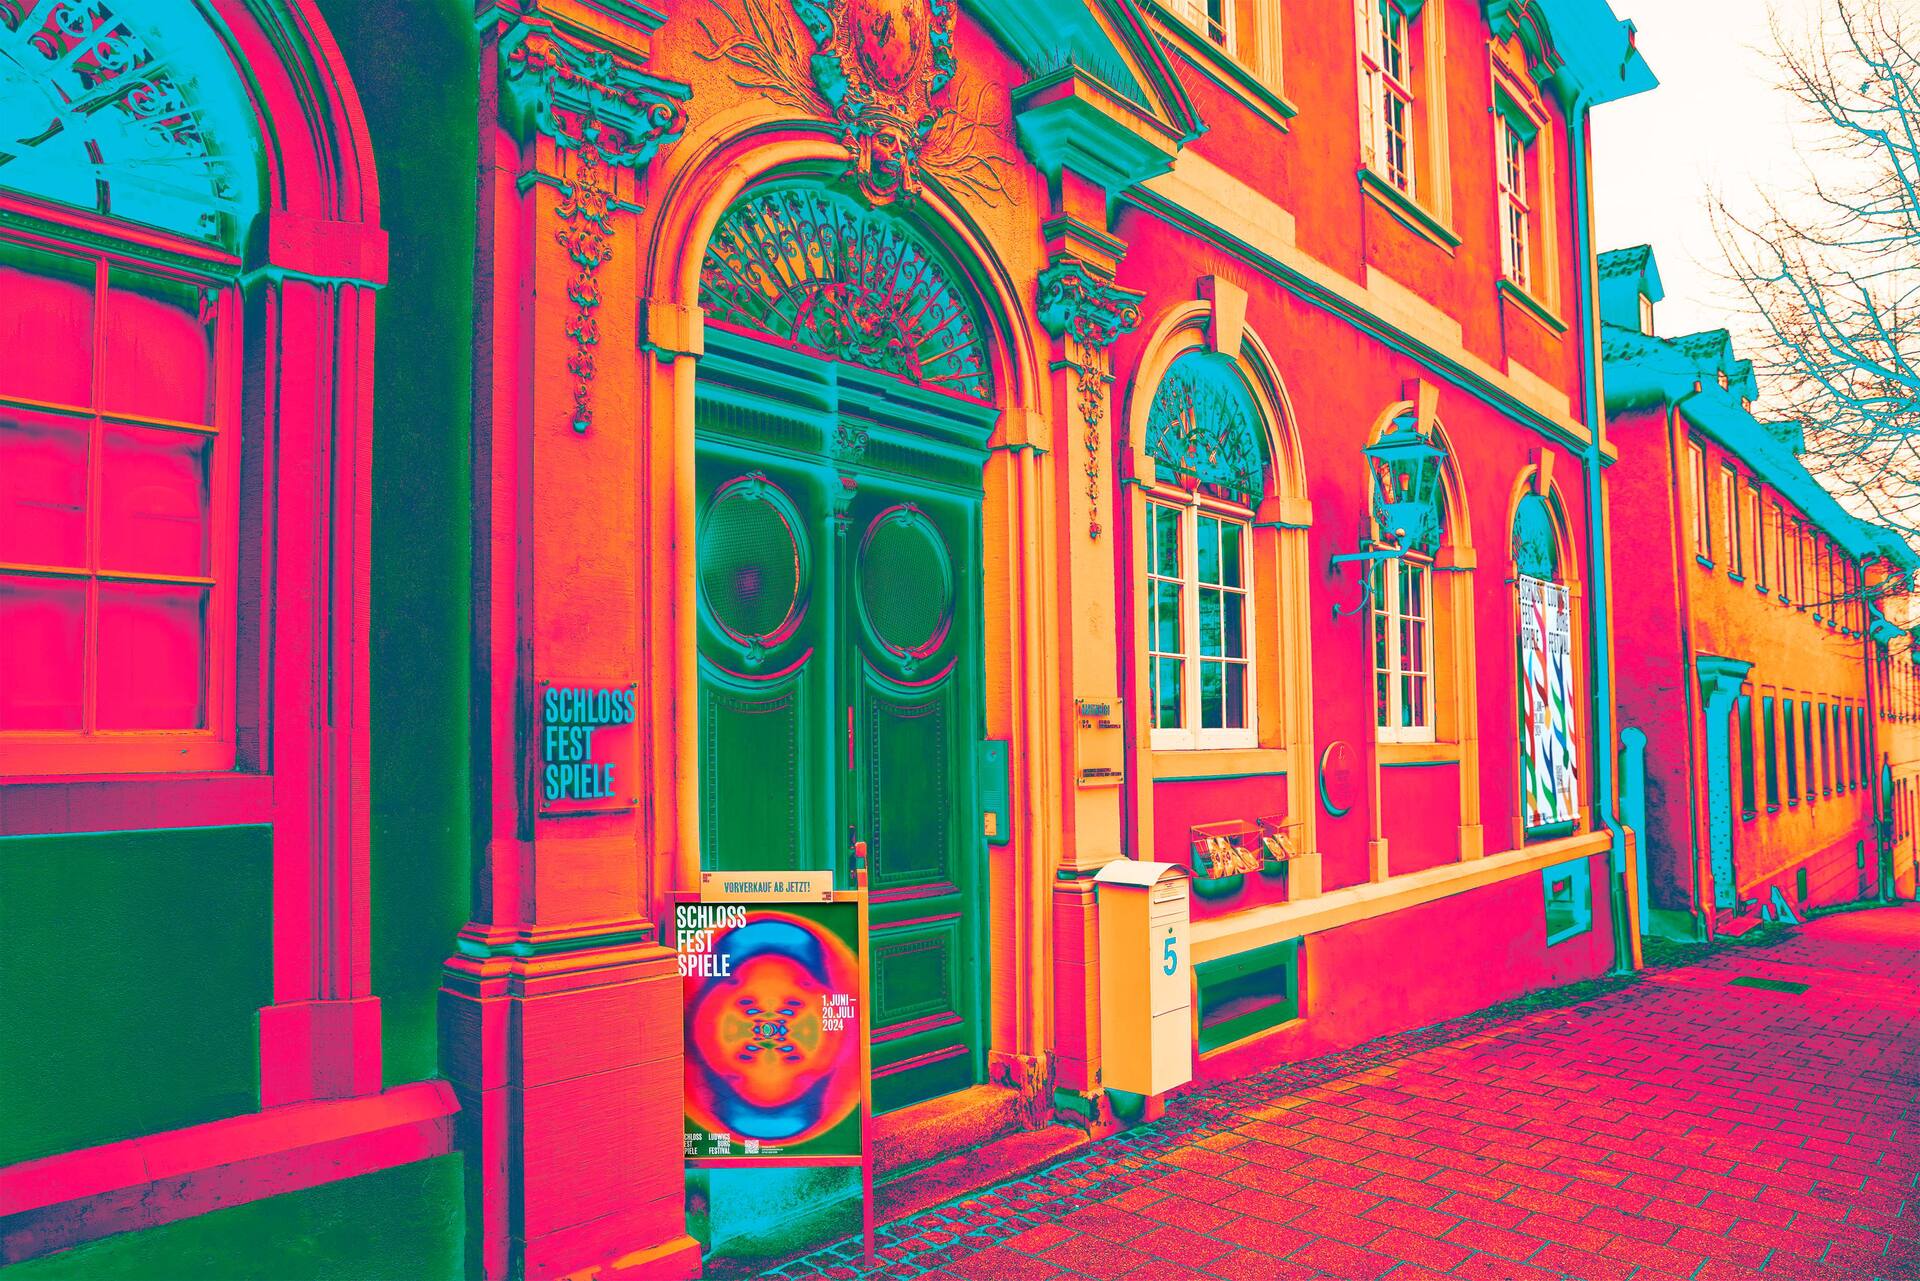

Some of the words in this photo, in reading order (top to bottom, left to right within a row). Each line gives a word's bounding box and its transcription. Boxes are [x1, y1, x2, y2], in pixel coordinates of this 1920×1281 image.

[546, 688, 635, 723] SCHLOSS
[546, 726, 595, 761] FEST
[546, 764, 615, 800] SPIELE
[724, 881, 772, 893] VORVERKAUF
[774, 881, 784, 893] AB
[786, 881, 811, 893] JETZT!
[677, 905, 747, 929] SCHLOSS
[677, 929, 714, 953] FEST
[677, 953, 731, 977] SPIELE
[1163, 936, 1178, 976] 5
[822, 1018, 844, 1031] 2024
[684, 1133, 702, 1141] CHLOSS
[684, 1147, 698, 1155] PIELE
[708, 1147, 731, 1155] FESTIVAL
